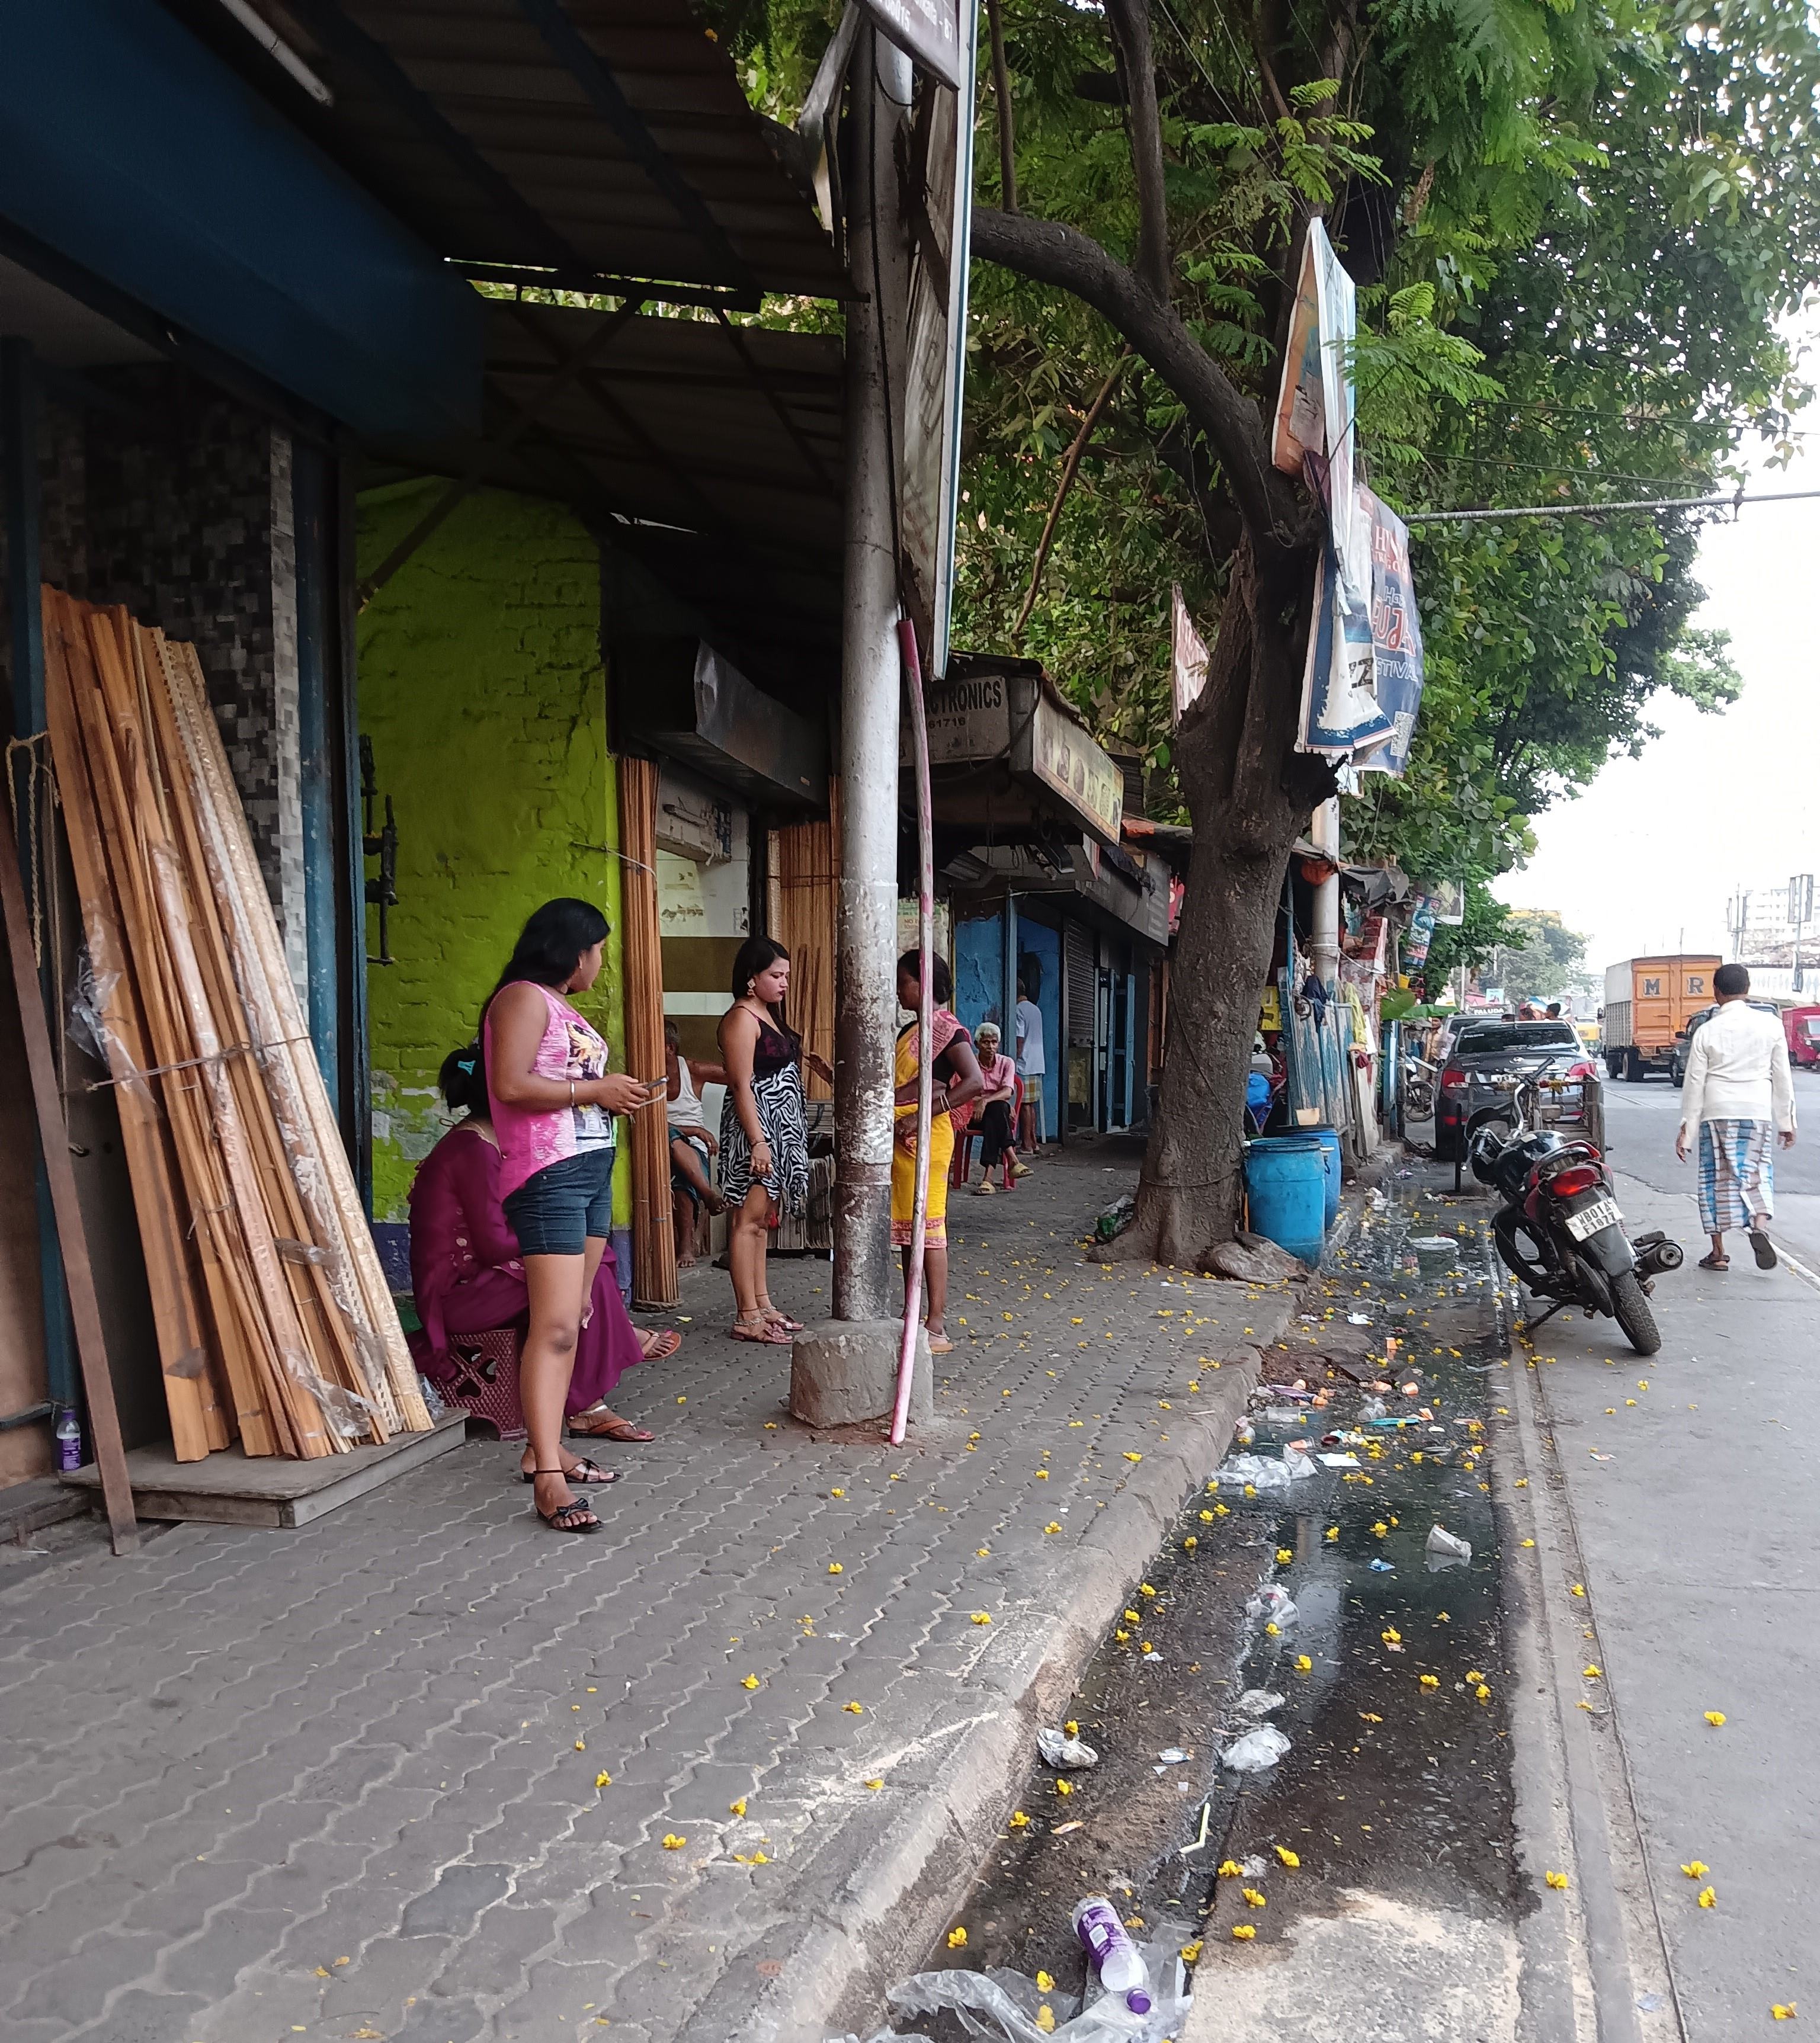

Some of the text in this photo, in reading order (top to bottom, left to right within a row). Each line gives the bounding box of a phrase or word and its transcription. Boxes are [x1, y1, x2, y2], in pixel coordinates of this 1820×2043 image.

[1644, 977, 1704, 996] M R
[1577, 1202, 1612, 1225] WB01A
